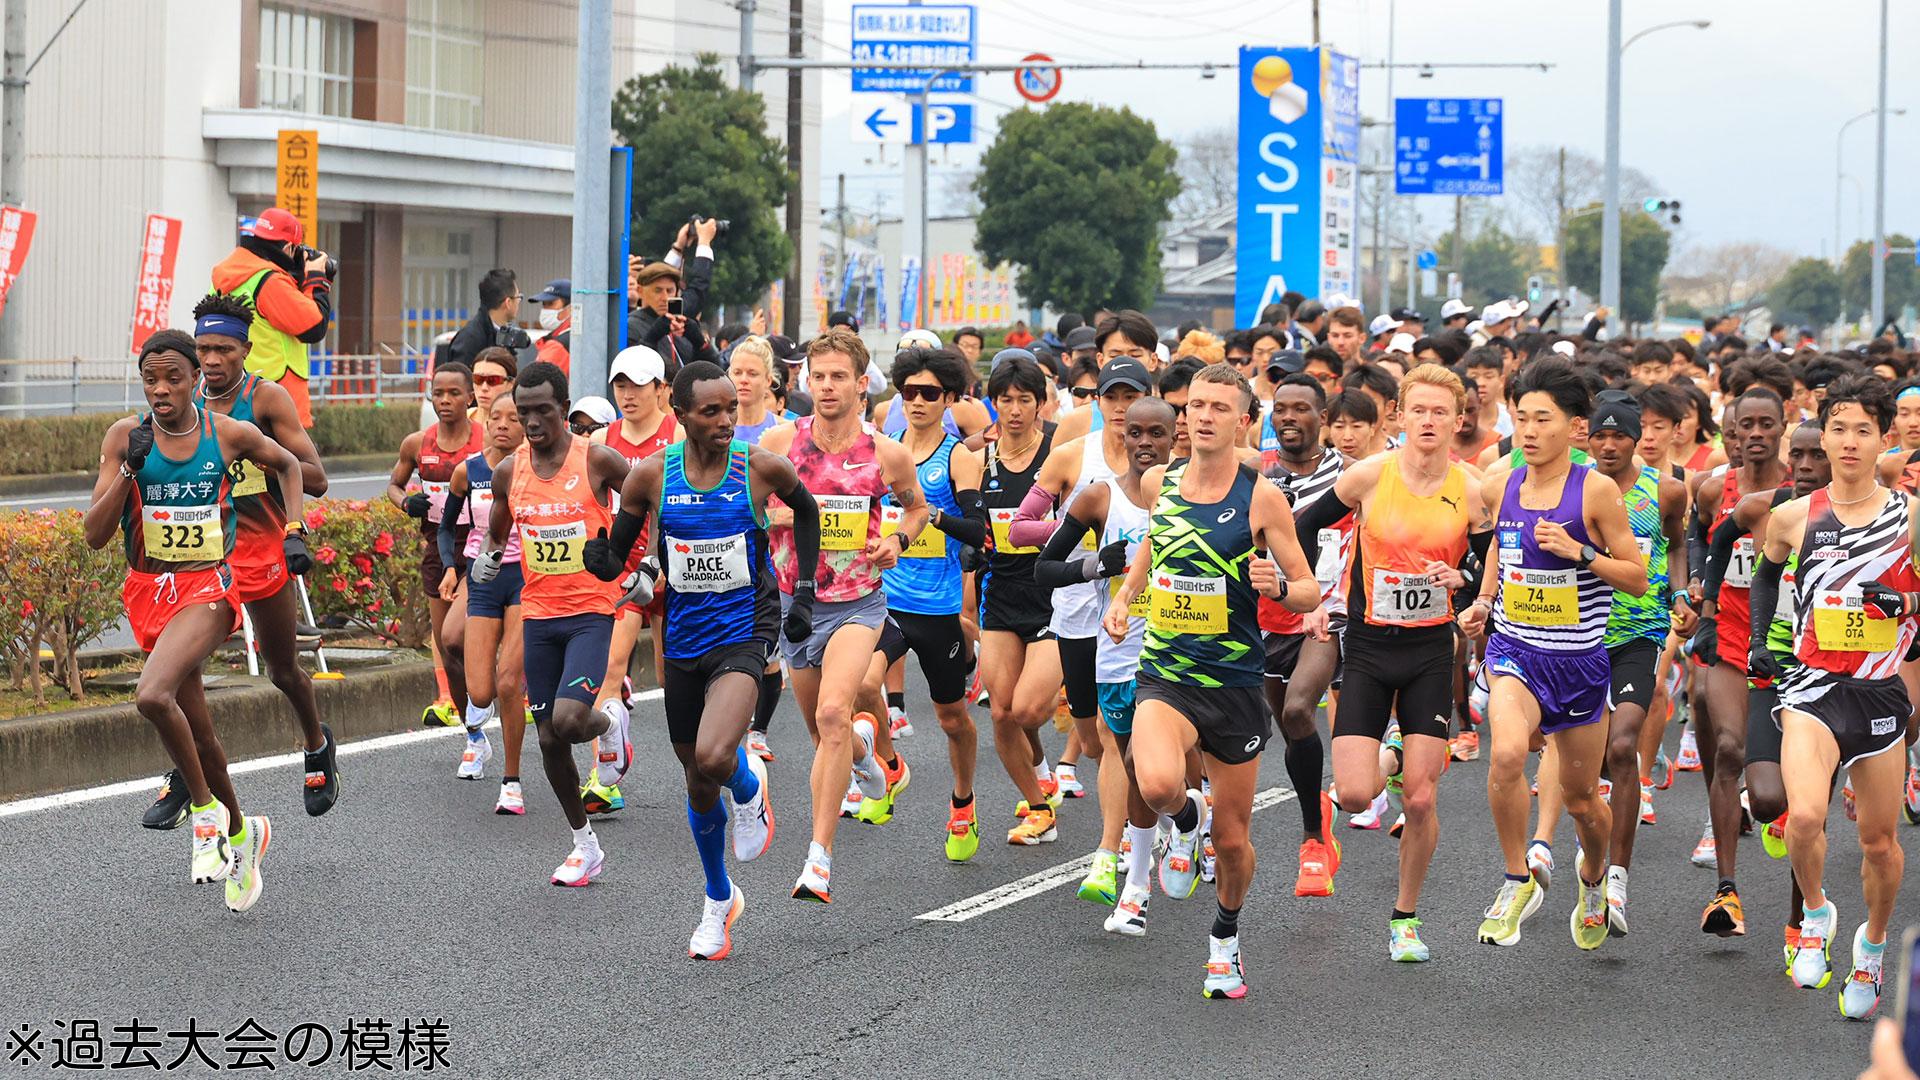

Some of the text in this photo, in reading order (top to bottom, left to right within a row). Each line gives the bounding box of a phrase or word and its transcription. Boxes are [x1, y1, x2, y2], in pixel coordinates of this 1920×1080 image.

[927, 106, 956, 140] P
[284, 134, 309, 238] 合流注
[667, 494, 705, 505] 中電工
[173, 509, 213, 522] 四国化成
[823, 513, 840, 528] 51
[161, 525, 204, 548] 323
[539, 528, 577, 539] 四国化成
[820, 528, 853, 538] BINSON
[534, 541, 572, 563] 322
[693, 540, 735, 553] 四国化成
[1813, 551, 1847, 559] TOYOTA
[687, 556, 724, 572] PACE
[682, 571, 732, 581] SHADRACK
[1526, 573, 1567, 585] 四国化成
[1173, 579, 1216, 593] 四国化成
[1392, 588, 1431, 611] 102
[1527, 588, 1544, 603] 74
[1879, 592, 1901, 602] TOYOTA
[1174, 595, 1192, 610] 52
[1513, 601, 1562, 613] SHINOHARA
[1160, 608, 1209, 622] BUCHANAN
[1846, 612, 1864, 628] 55
[1845, 628, 1865, 639] OTA
[1873, 718, 1894, 727] MOVE
